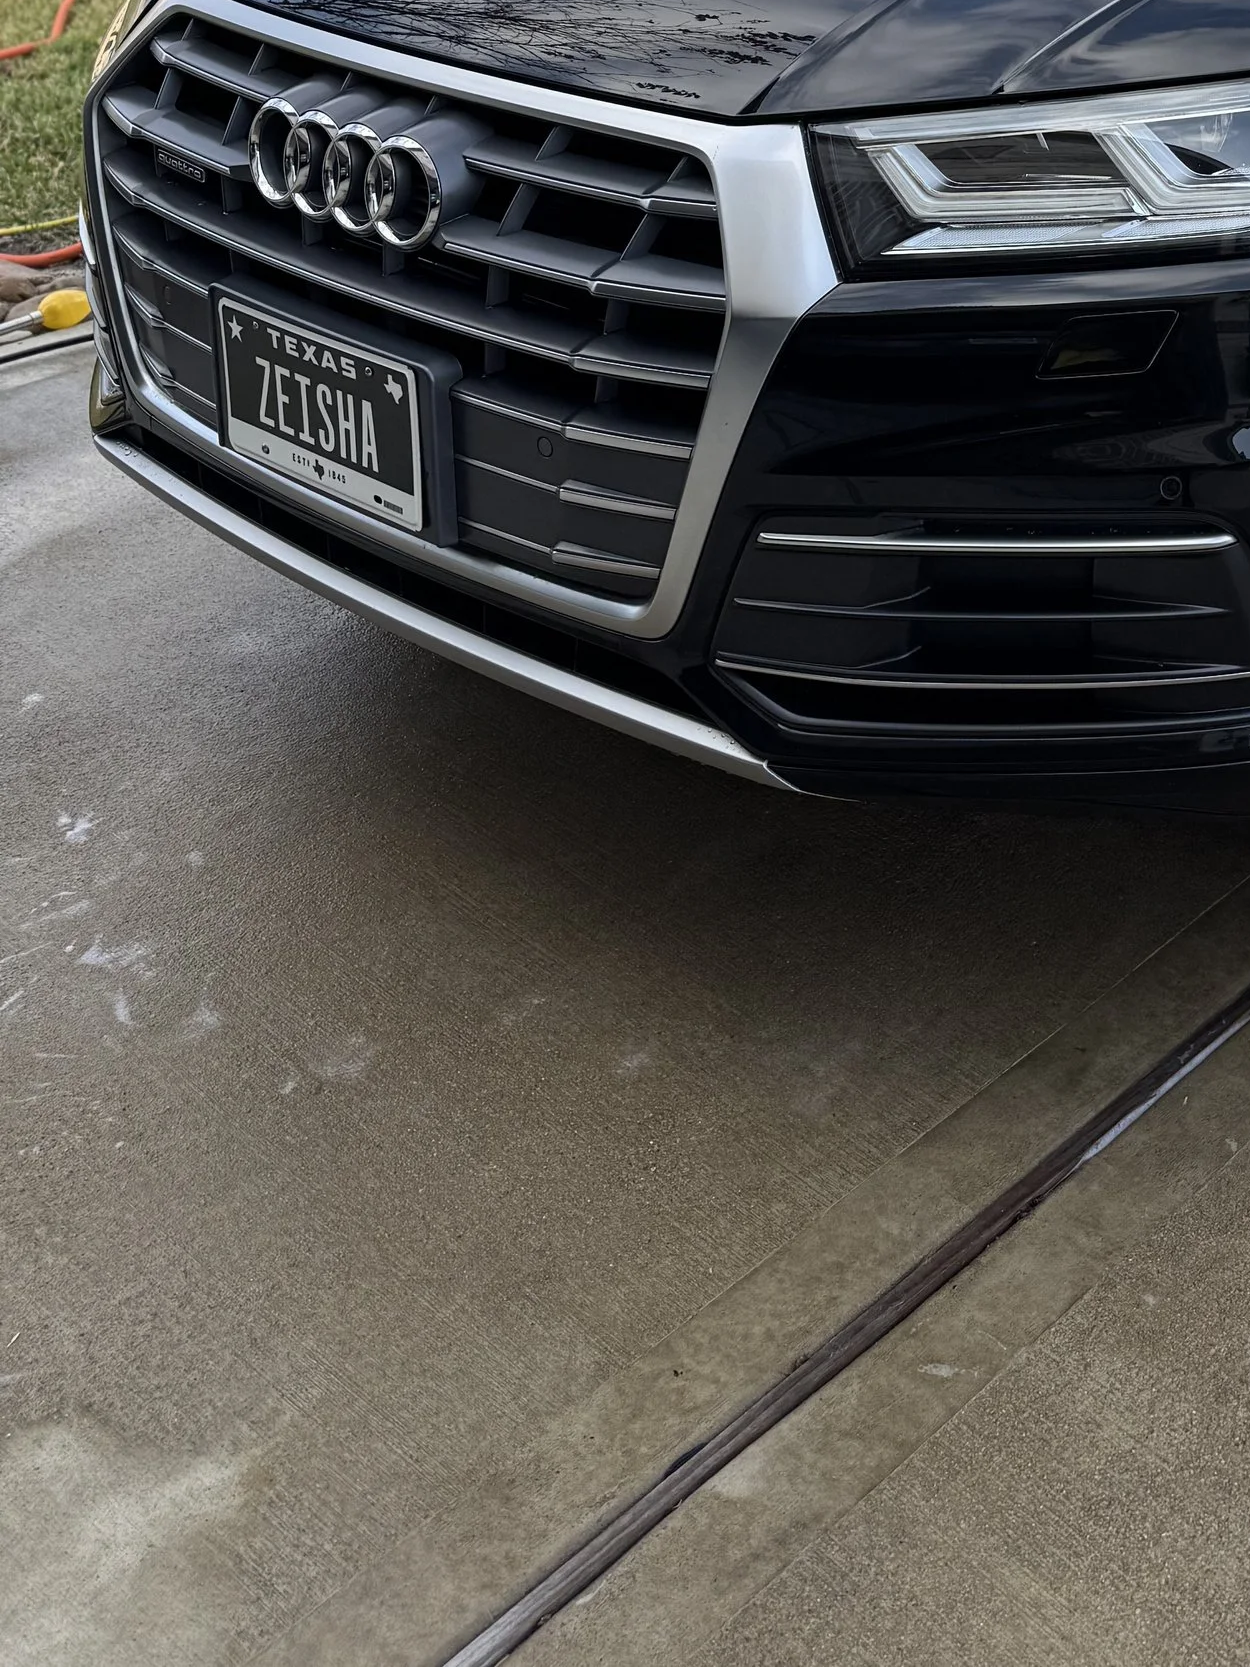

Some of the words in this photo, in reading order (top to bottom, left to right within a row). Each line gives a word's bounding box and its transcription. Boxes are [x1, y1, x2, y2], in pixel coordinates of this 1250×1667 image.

[158, 153, 202, 179] quattro
[266, 327, 357, 380] TEXAS
[255, 356, 380, 474] ZEISHA
[328, 469, 346, 484] 1845
